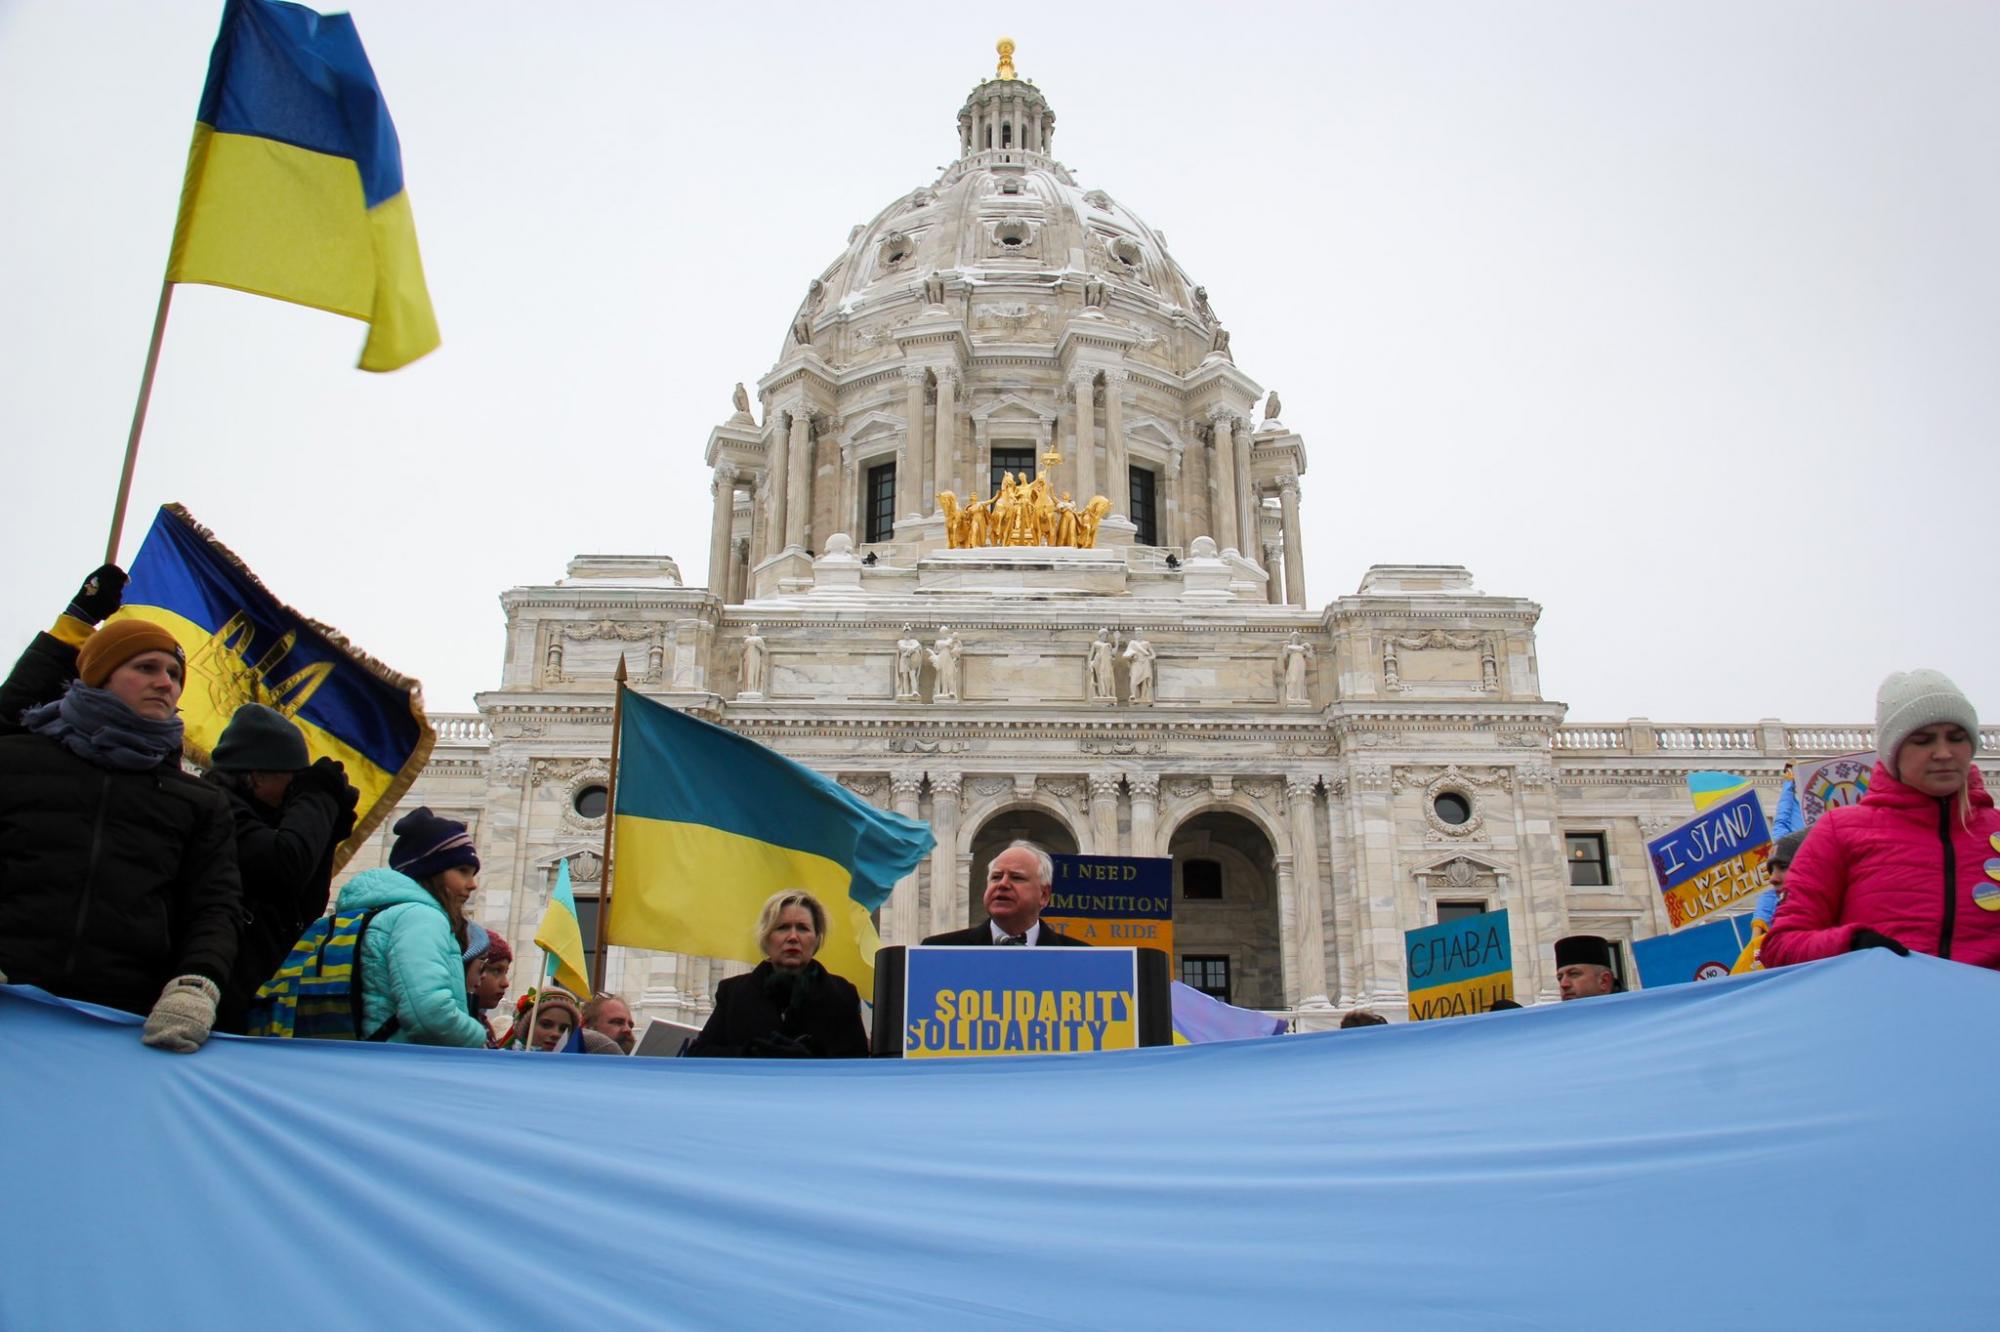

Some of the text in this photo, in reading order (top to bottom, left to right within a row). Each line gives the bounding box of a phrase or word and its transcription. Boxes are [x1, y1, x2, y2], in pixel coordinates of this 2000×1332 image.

[1659, 804, 1752, 875] I STAND
[1078, 863, 1137, 880] NEED
[1693, 854, 1745, 892] WITH
[1049, 892, 1168, 912] MUNITION
[1683, 861, 1770, 918] UKRAINE
[1085, 923, 1097, 938] A
[1109, 924, 1158, 939] RIDE
[1409, 927, 1504, 979] СЛАВА
[1706, 969, 1718, 979] NO
[935, 989, 1134, 1022] SOLIDARITY
[907, 1018, 1108, 1051] SOLIDARITY
